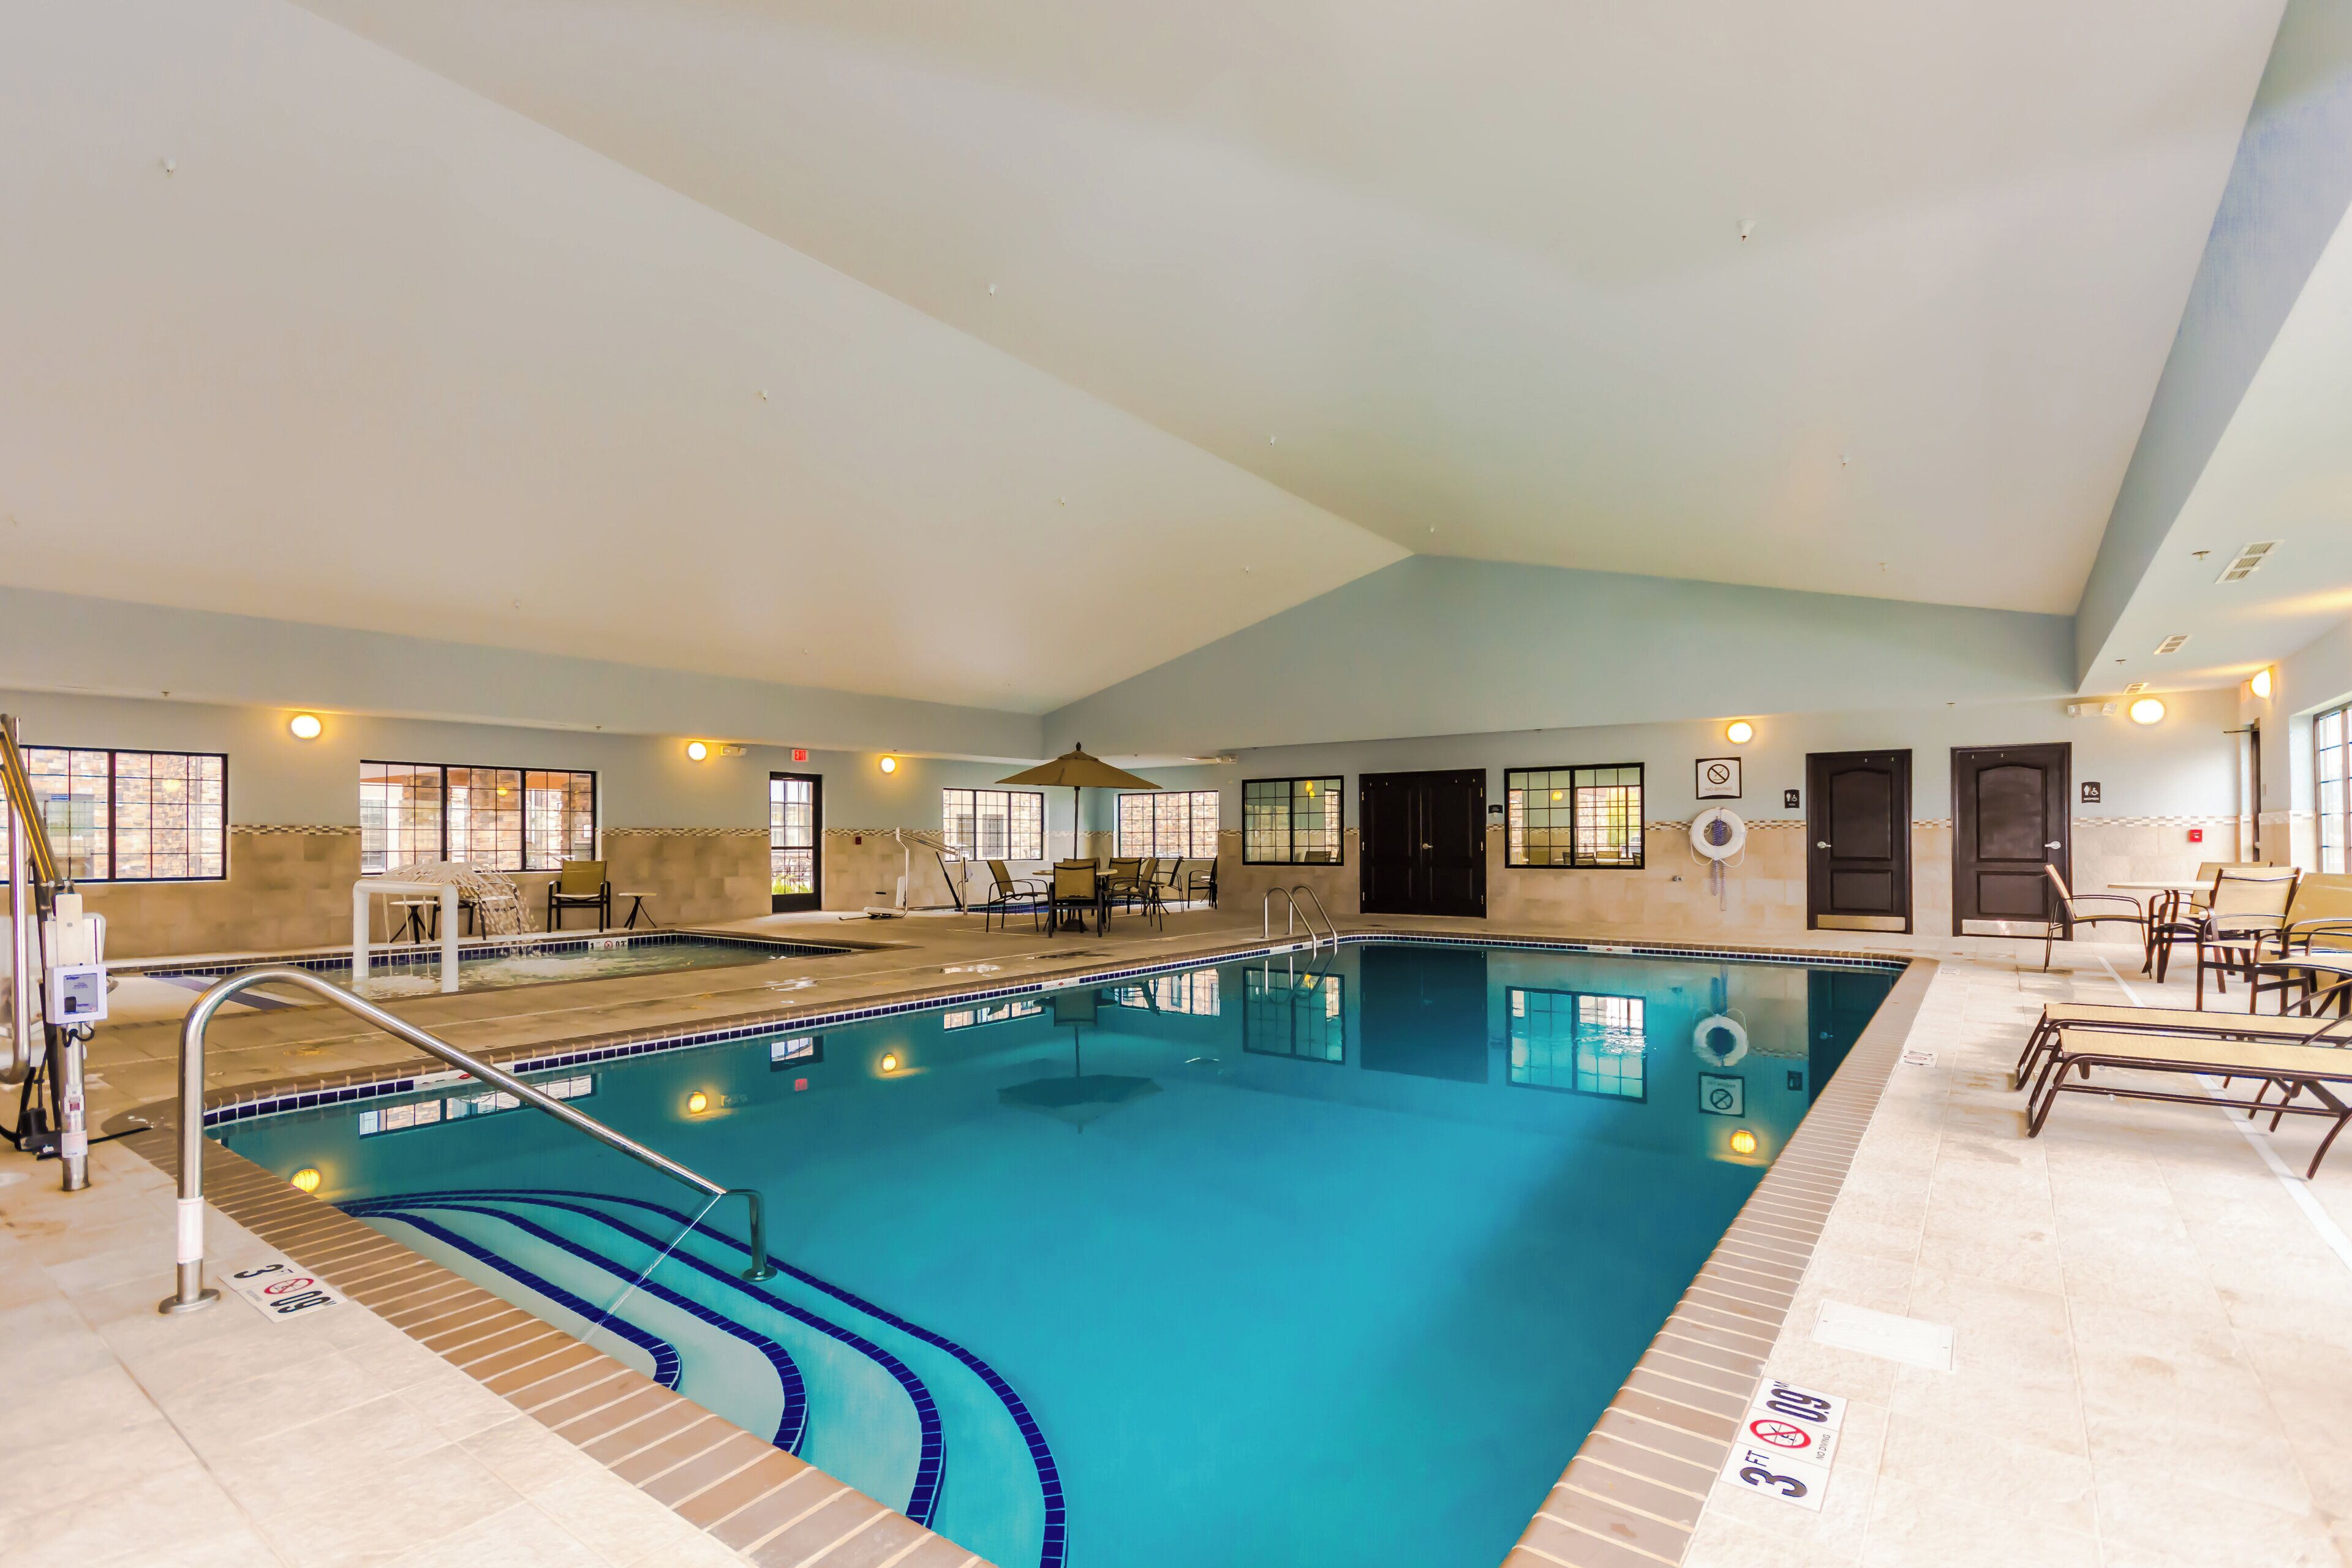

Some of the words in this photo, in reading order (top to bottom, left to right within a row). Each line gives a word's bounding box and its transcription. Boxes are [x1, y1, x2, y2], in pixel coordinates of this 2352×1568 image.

[794, 750, 807, 761] EXIT
[233, 1264, 284, 1279] 3
[1818, 1434, 1831, 1451] DIVING
[1744, 1450, 1770, 1467] FT
[1815, 1451, 1825, 1460] NO
[1740, 1466, 1808, 1498] 3
